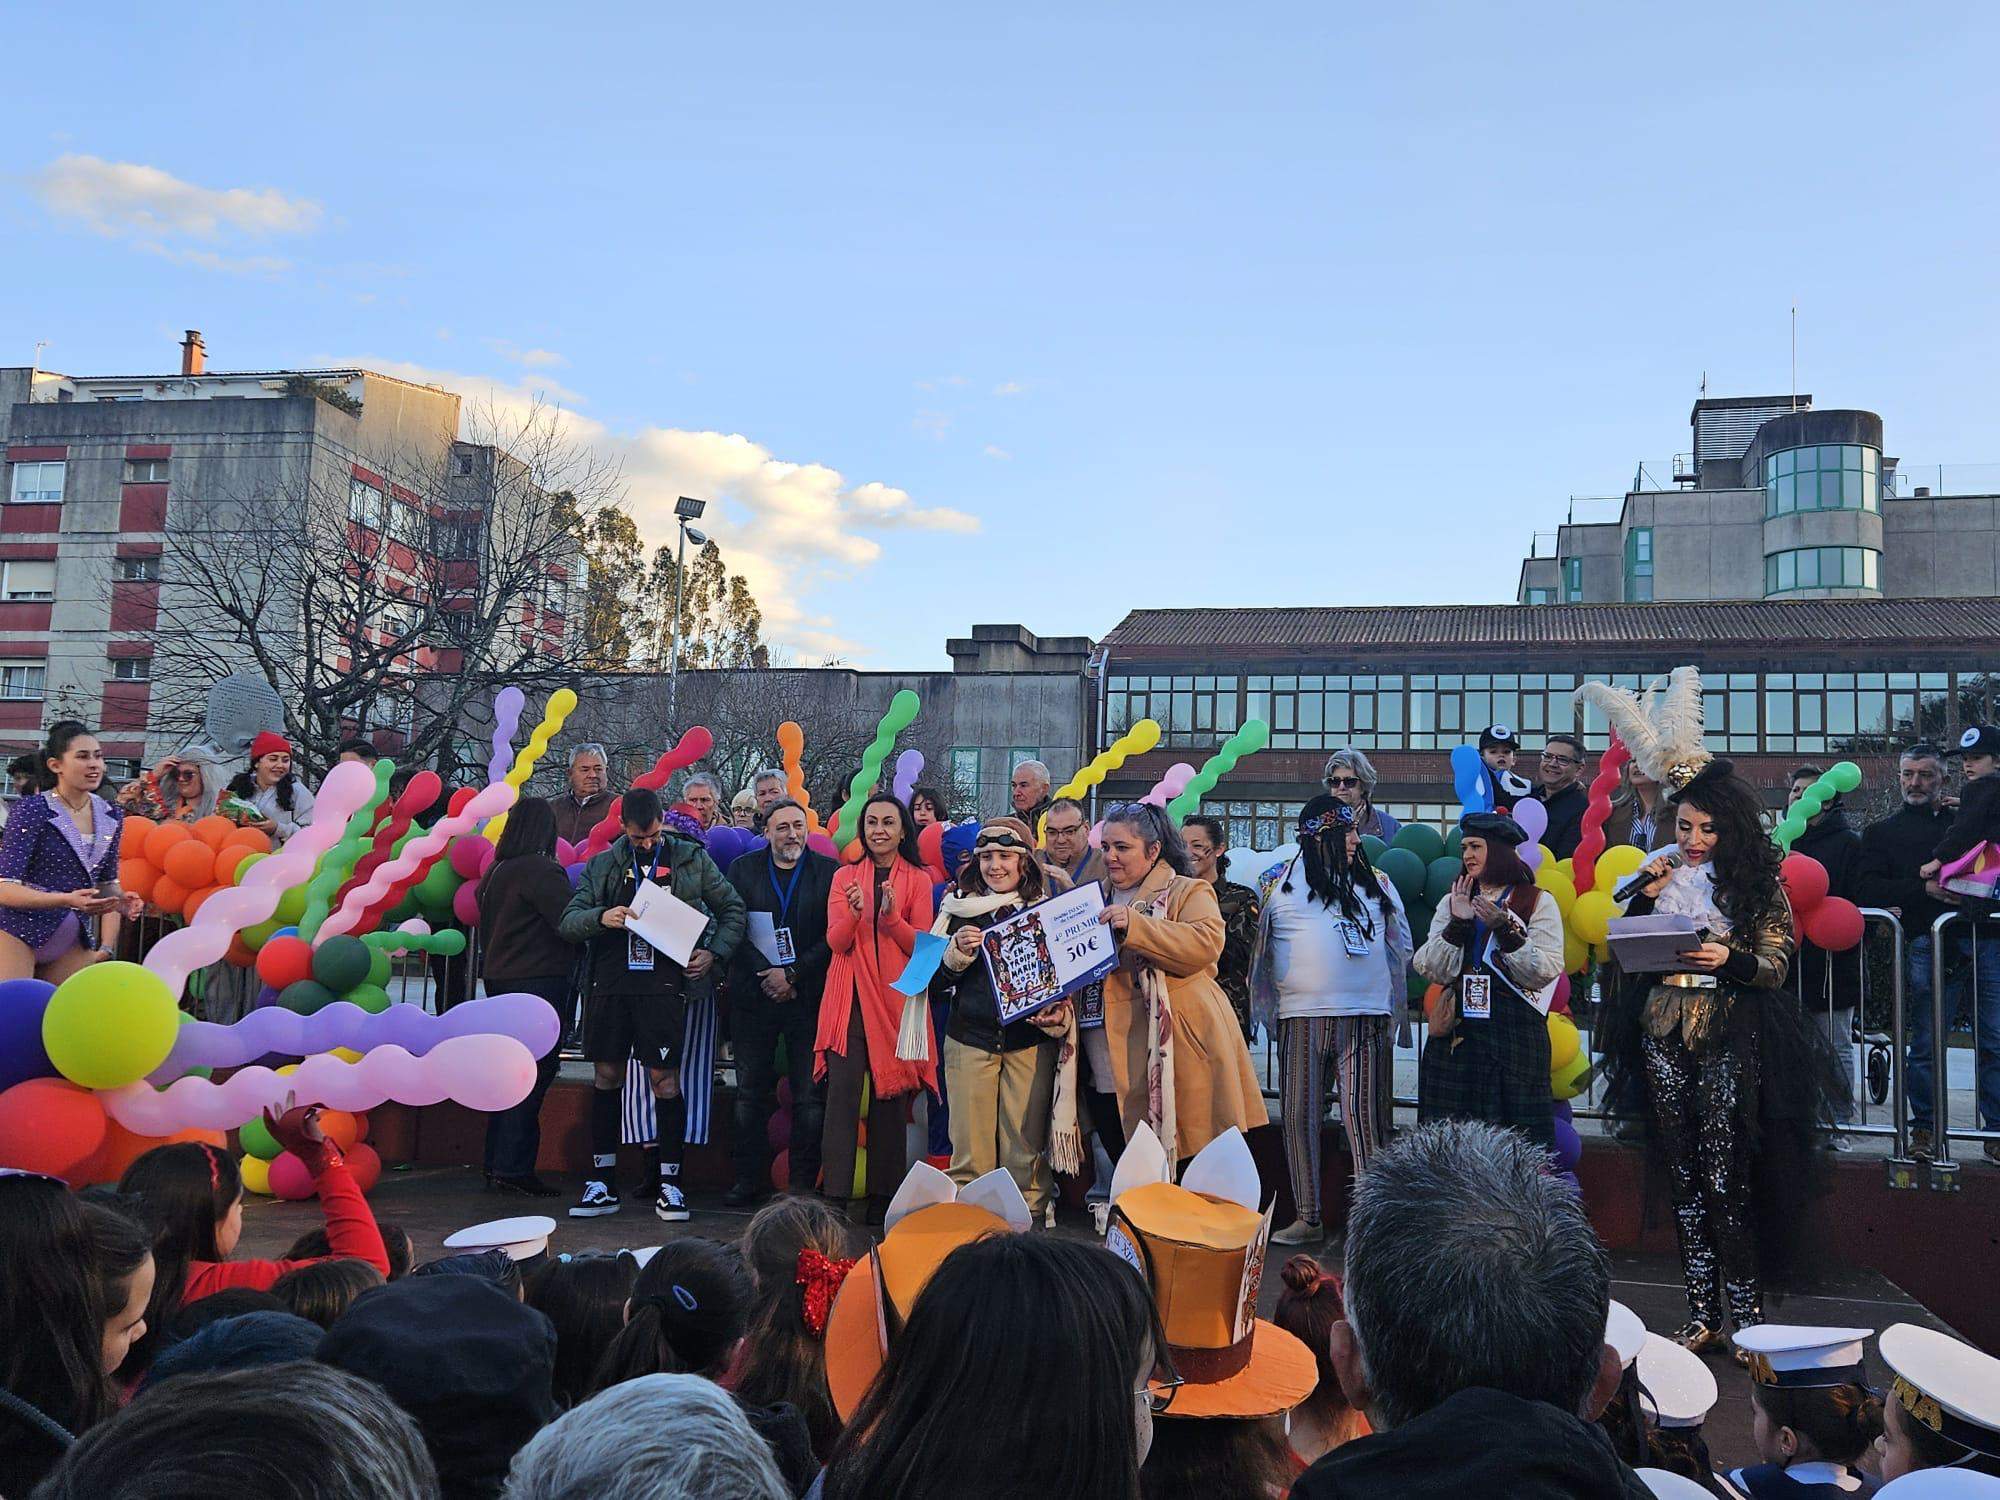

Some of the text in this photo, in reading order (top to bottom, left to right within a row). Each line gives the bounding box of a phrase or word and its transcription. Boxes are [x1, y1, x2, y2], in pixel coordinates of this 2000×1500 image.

[1013, 946, 1027, 957] EN-
[1067, 935, 1099, 962] 50€
[1010, 952, 1036, 969] TROIDO
[1011, 960, 1037, 979] MARÍN
[1016, 971, 1036, 986] 2025
